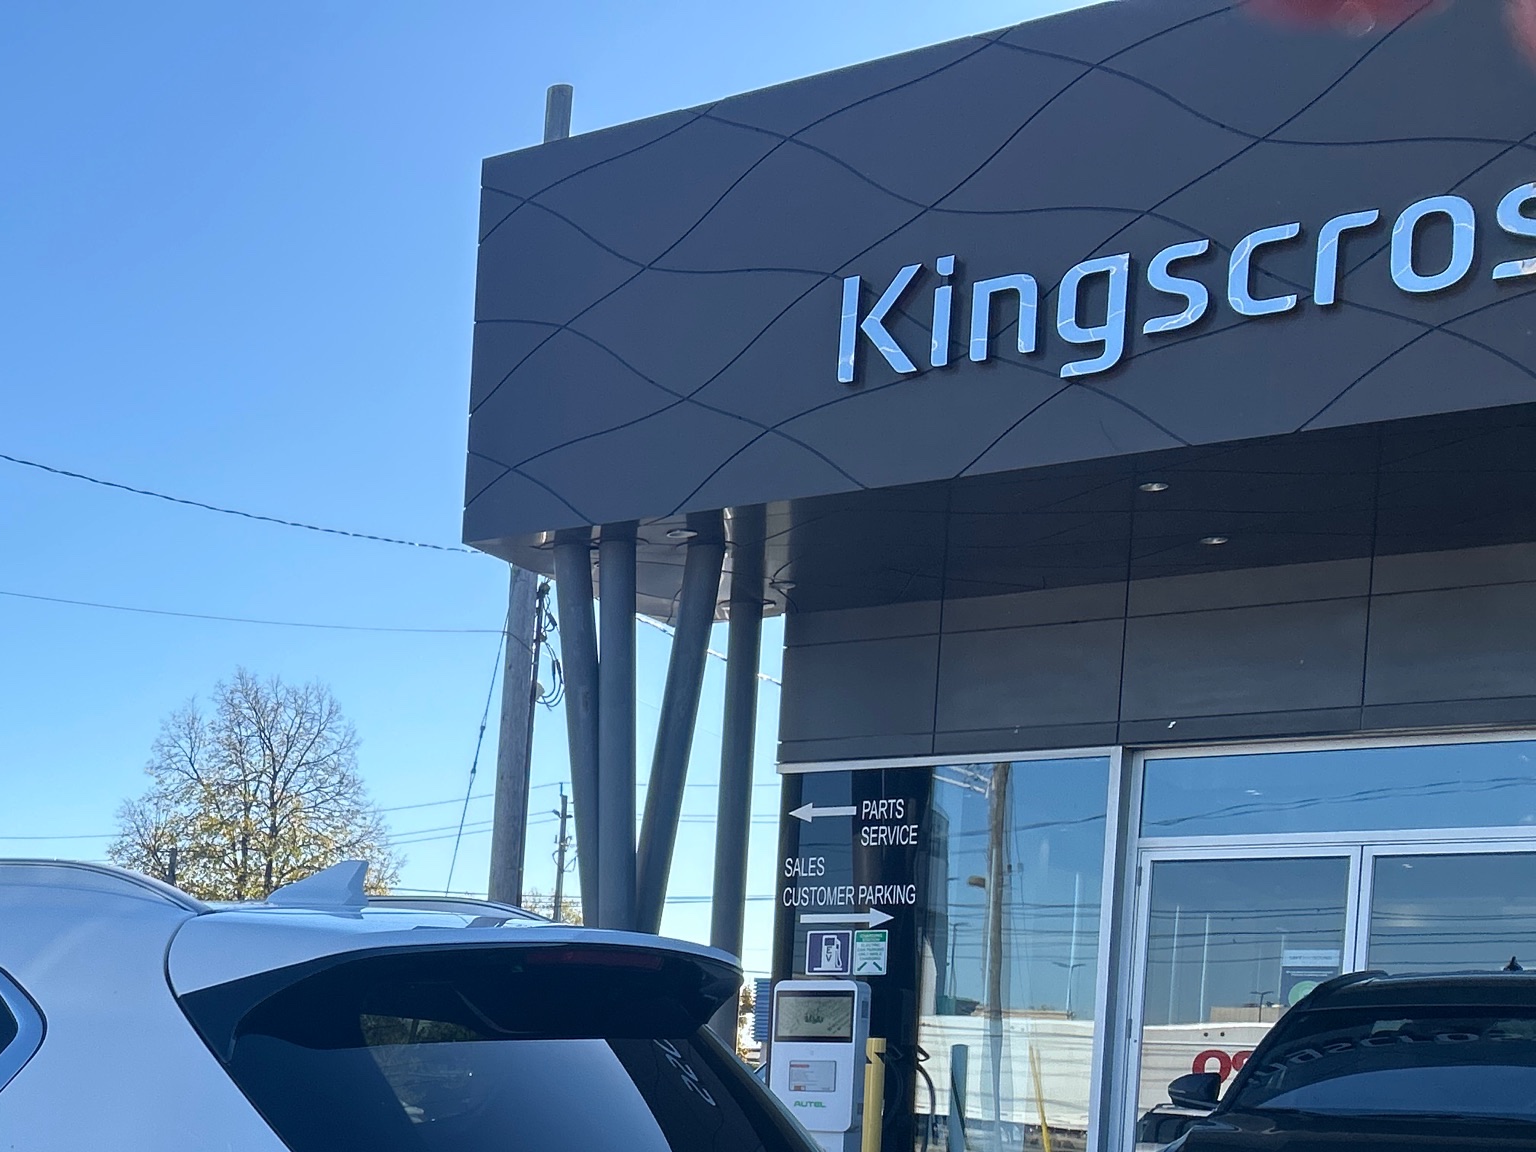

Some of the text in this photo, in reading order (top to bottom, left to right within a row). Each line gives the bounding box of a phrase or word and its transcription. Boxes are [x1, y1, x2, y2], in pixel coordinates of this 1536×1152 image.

[861, 799, 904, 820] PARTS
[860, 825, 918, 846] SERVICE
[784, 857, 825, 877] SALES
[783, 884, 916, 907] CUSTOMER PARKING
[793, 1100, 827, 1108] AUTEL
